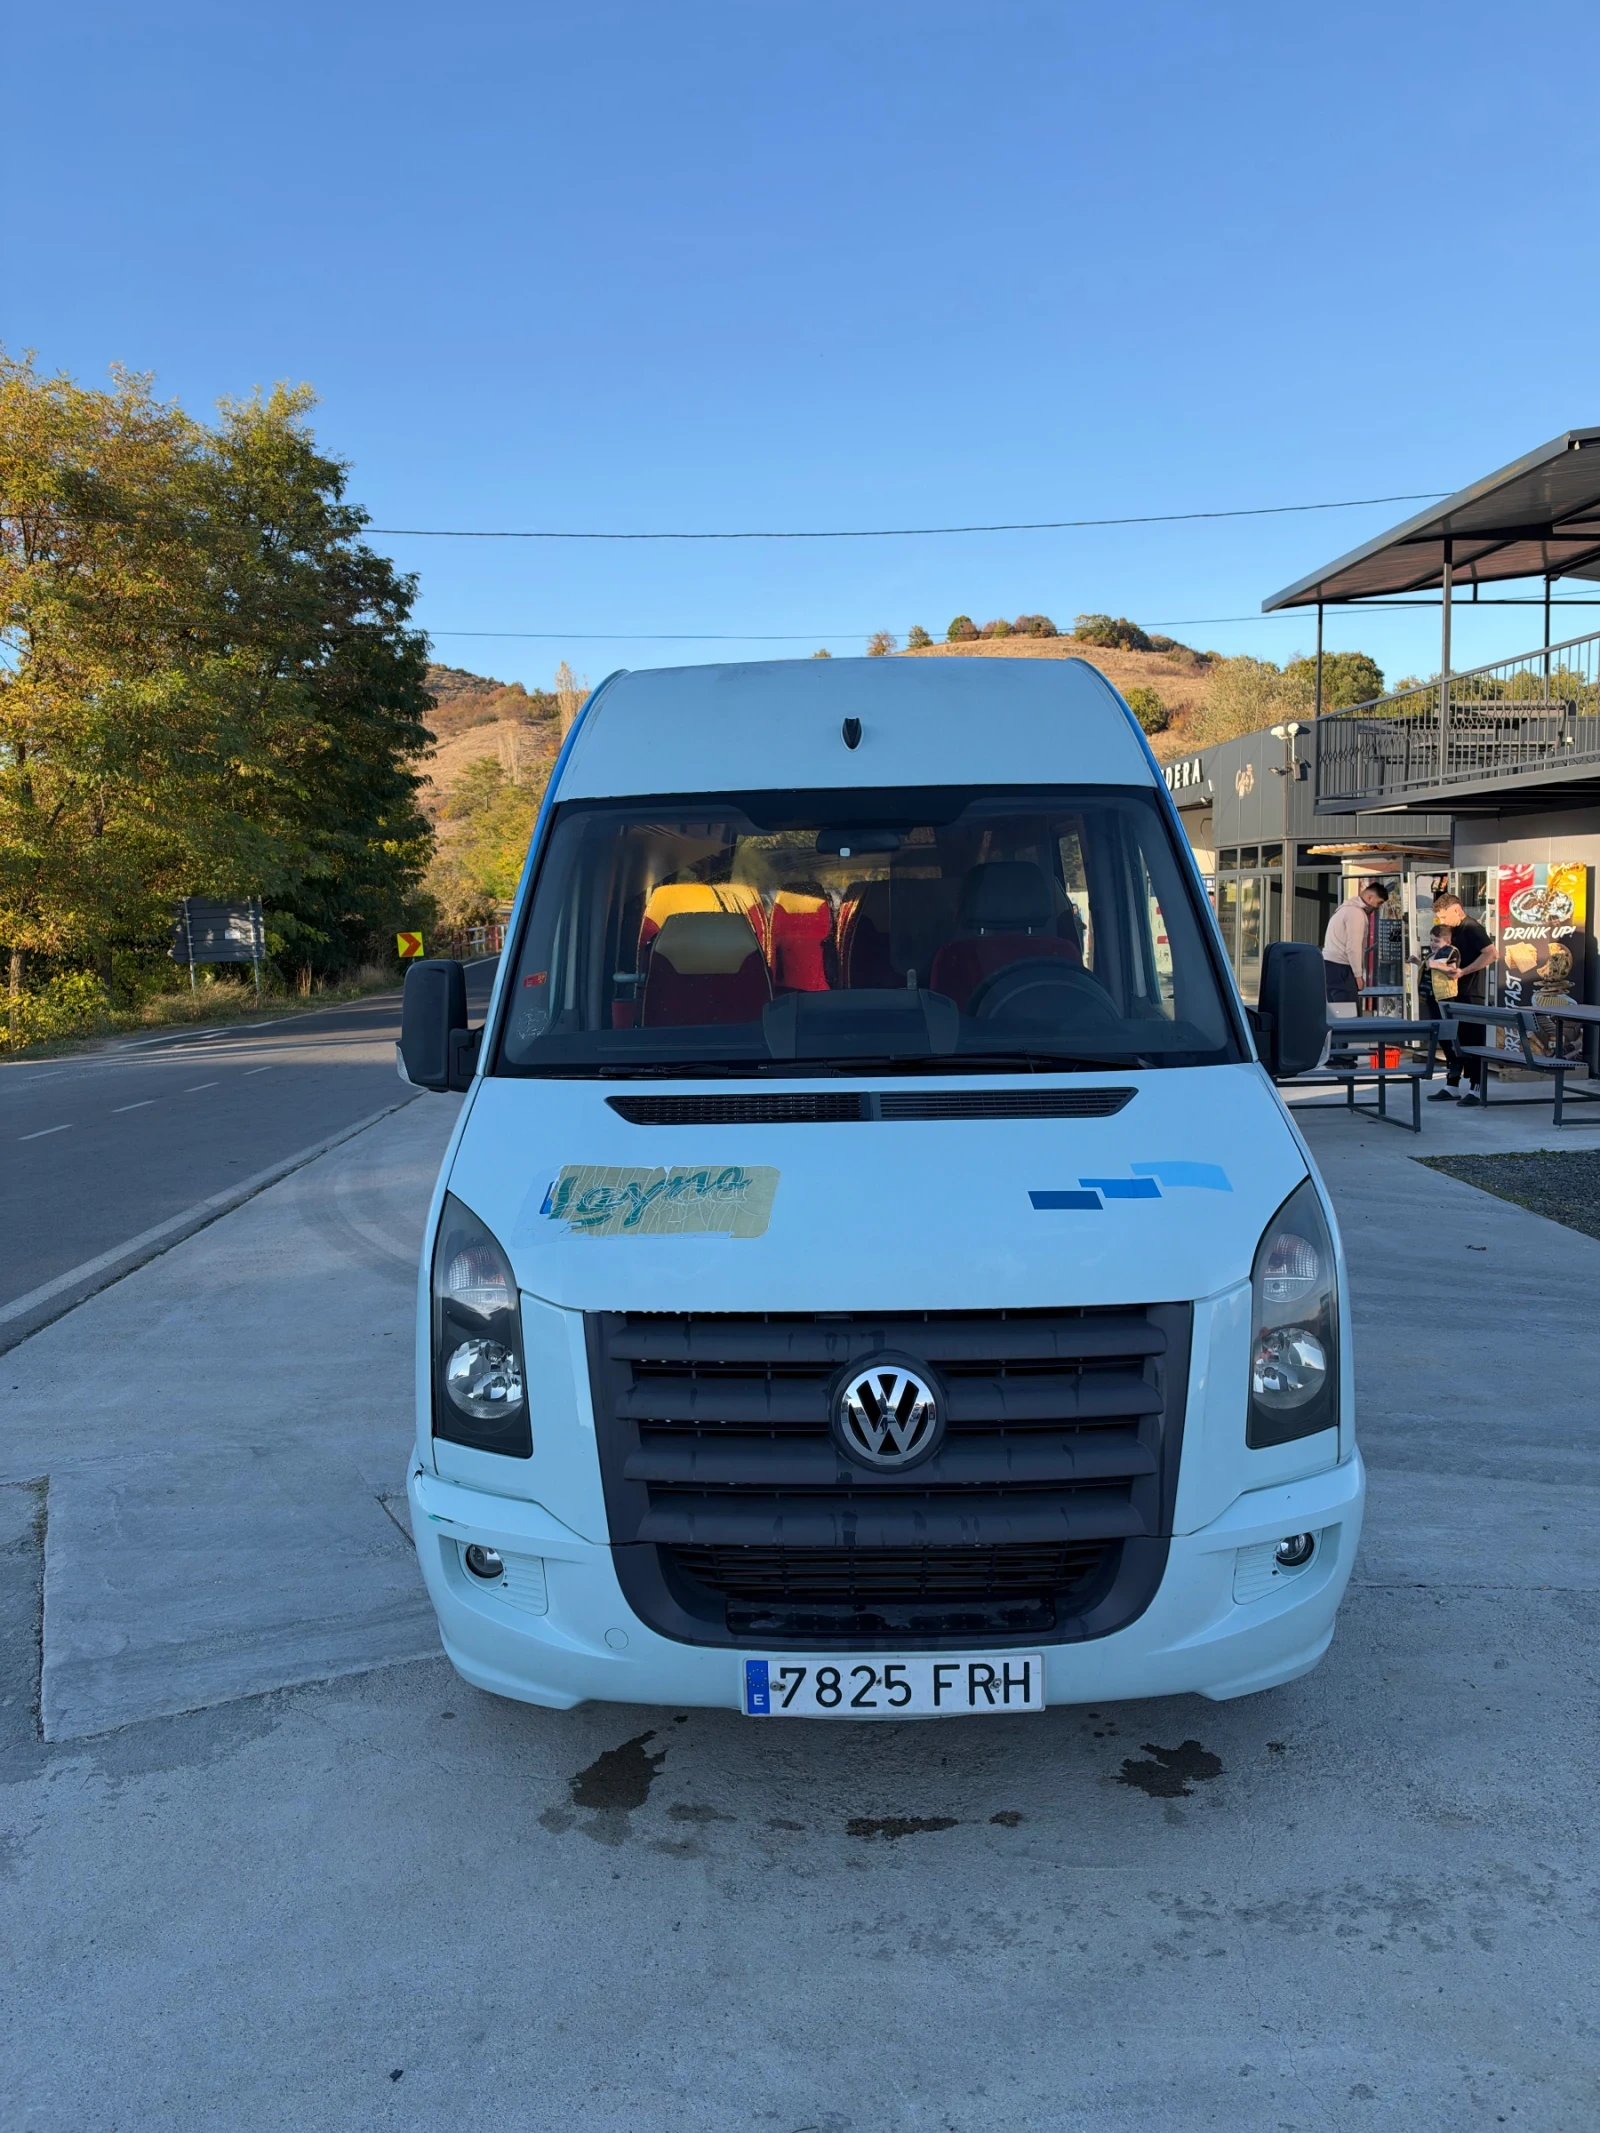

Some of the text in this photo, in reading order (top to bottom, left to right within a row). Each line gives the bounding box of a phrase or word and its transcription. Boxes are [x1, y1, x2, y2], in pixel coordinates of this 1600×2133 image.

[1160, 758, 1201, 792] DERA
[1503, 926, 1576, 940] DRINK UP!
[841, 1366, 936, 1465] VW
[753, 1693, 764, 1706] E
[779, 1661, 1030, 1708] 7825 FRH
